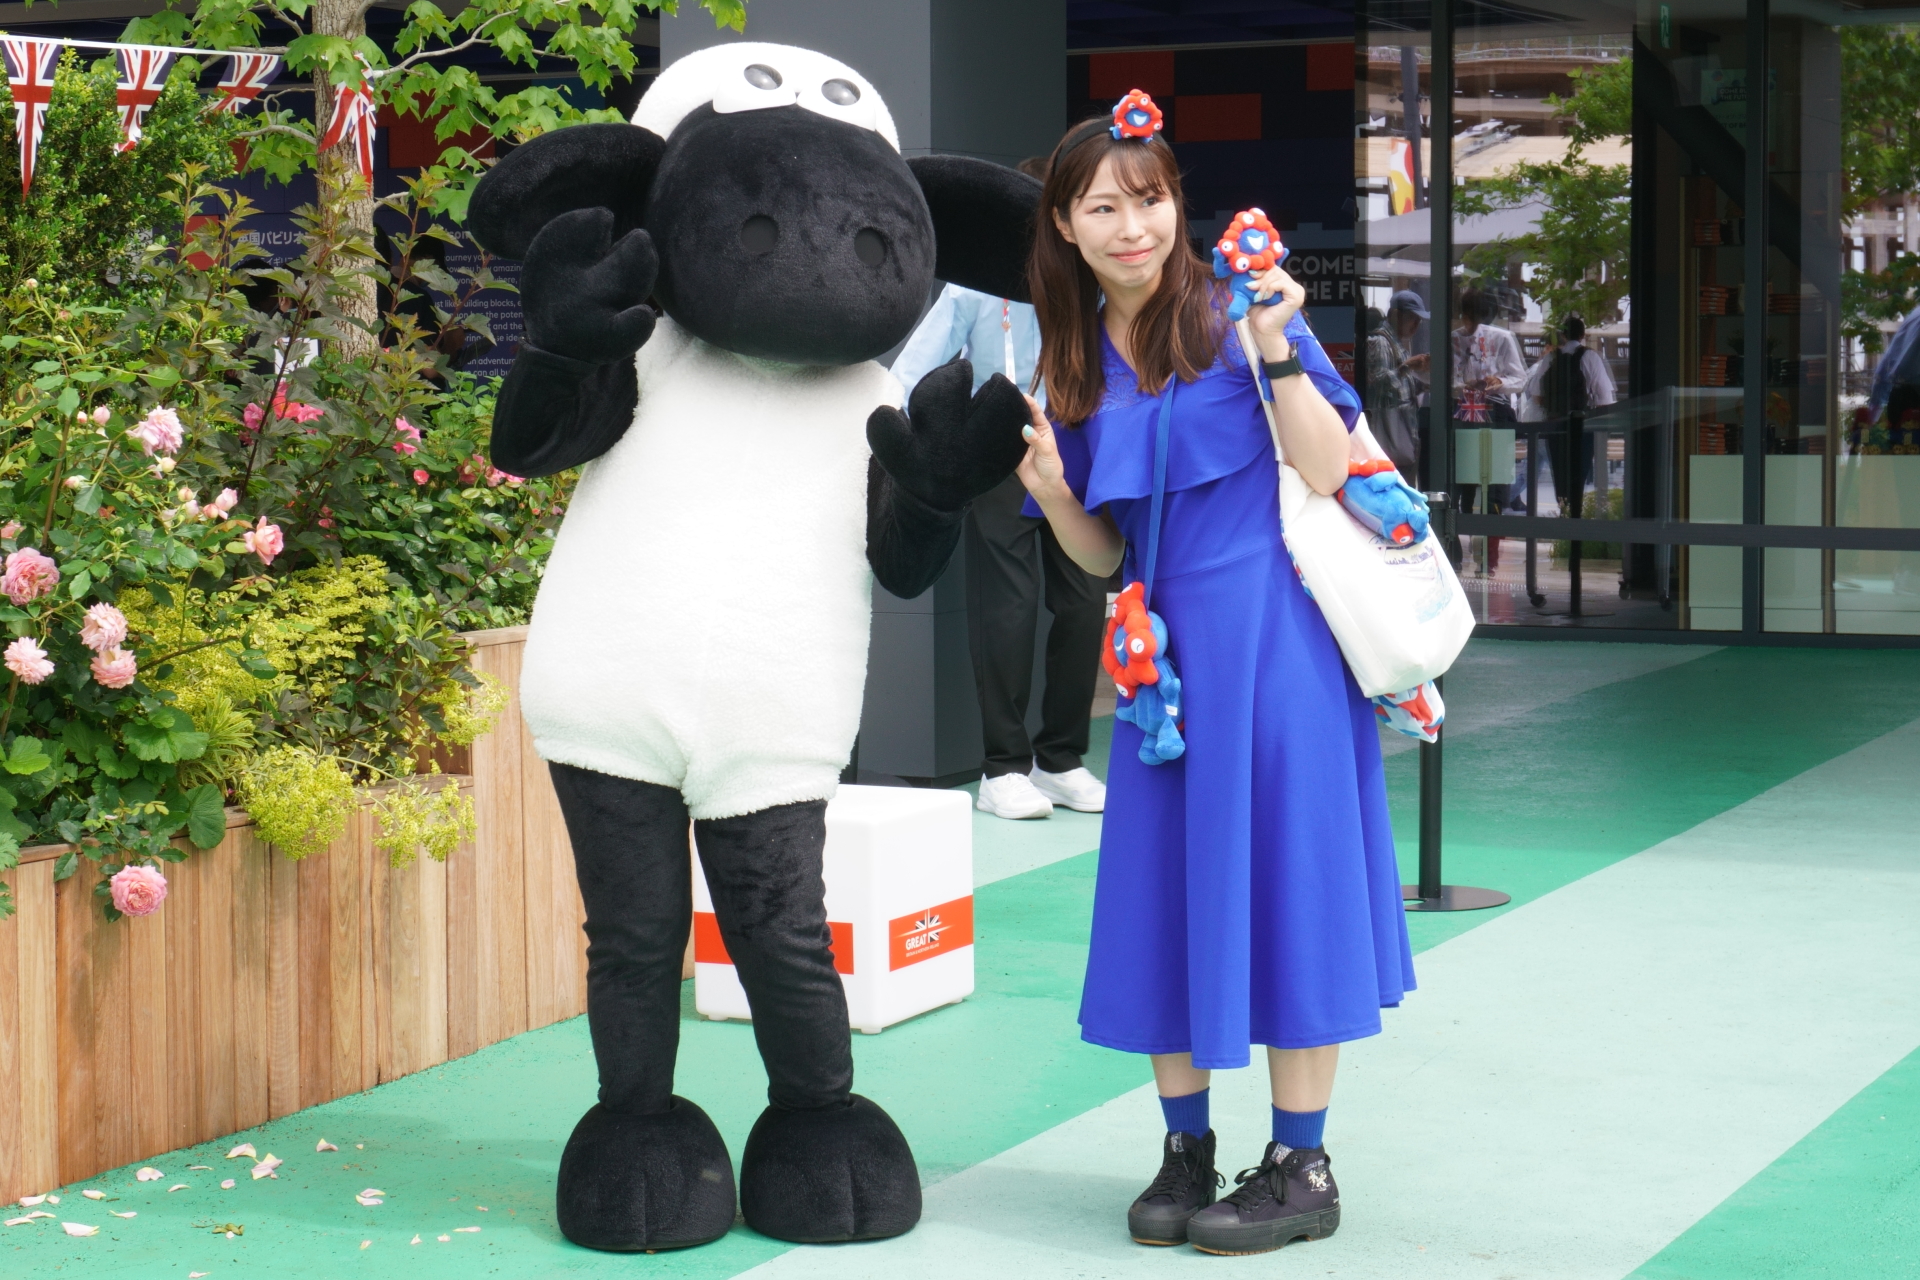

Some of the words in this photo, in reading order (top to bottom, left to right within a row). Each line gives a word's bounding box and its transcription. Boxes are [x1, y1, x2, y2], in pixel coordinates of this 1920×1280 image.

[445, 254, 472, 262] ourney
[493, 264, 523, 272] amazin
[1286, 255, 1354, 275] COME
[1298, 281, 1332, 300] HE
[490, 299, 516, 308] blocks,
[500, 312, 523, 320] poten
[505, 333, 518, 341] ide
[1334, 362, 1355, 372] EAT
[906, 934, 927, 951] GREAT
